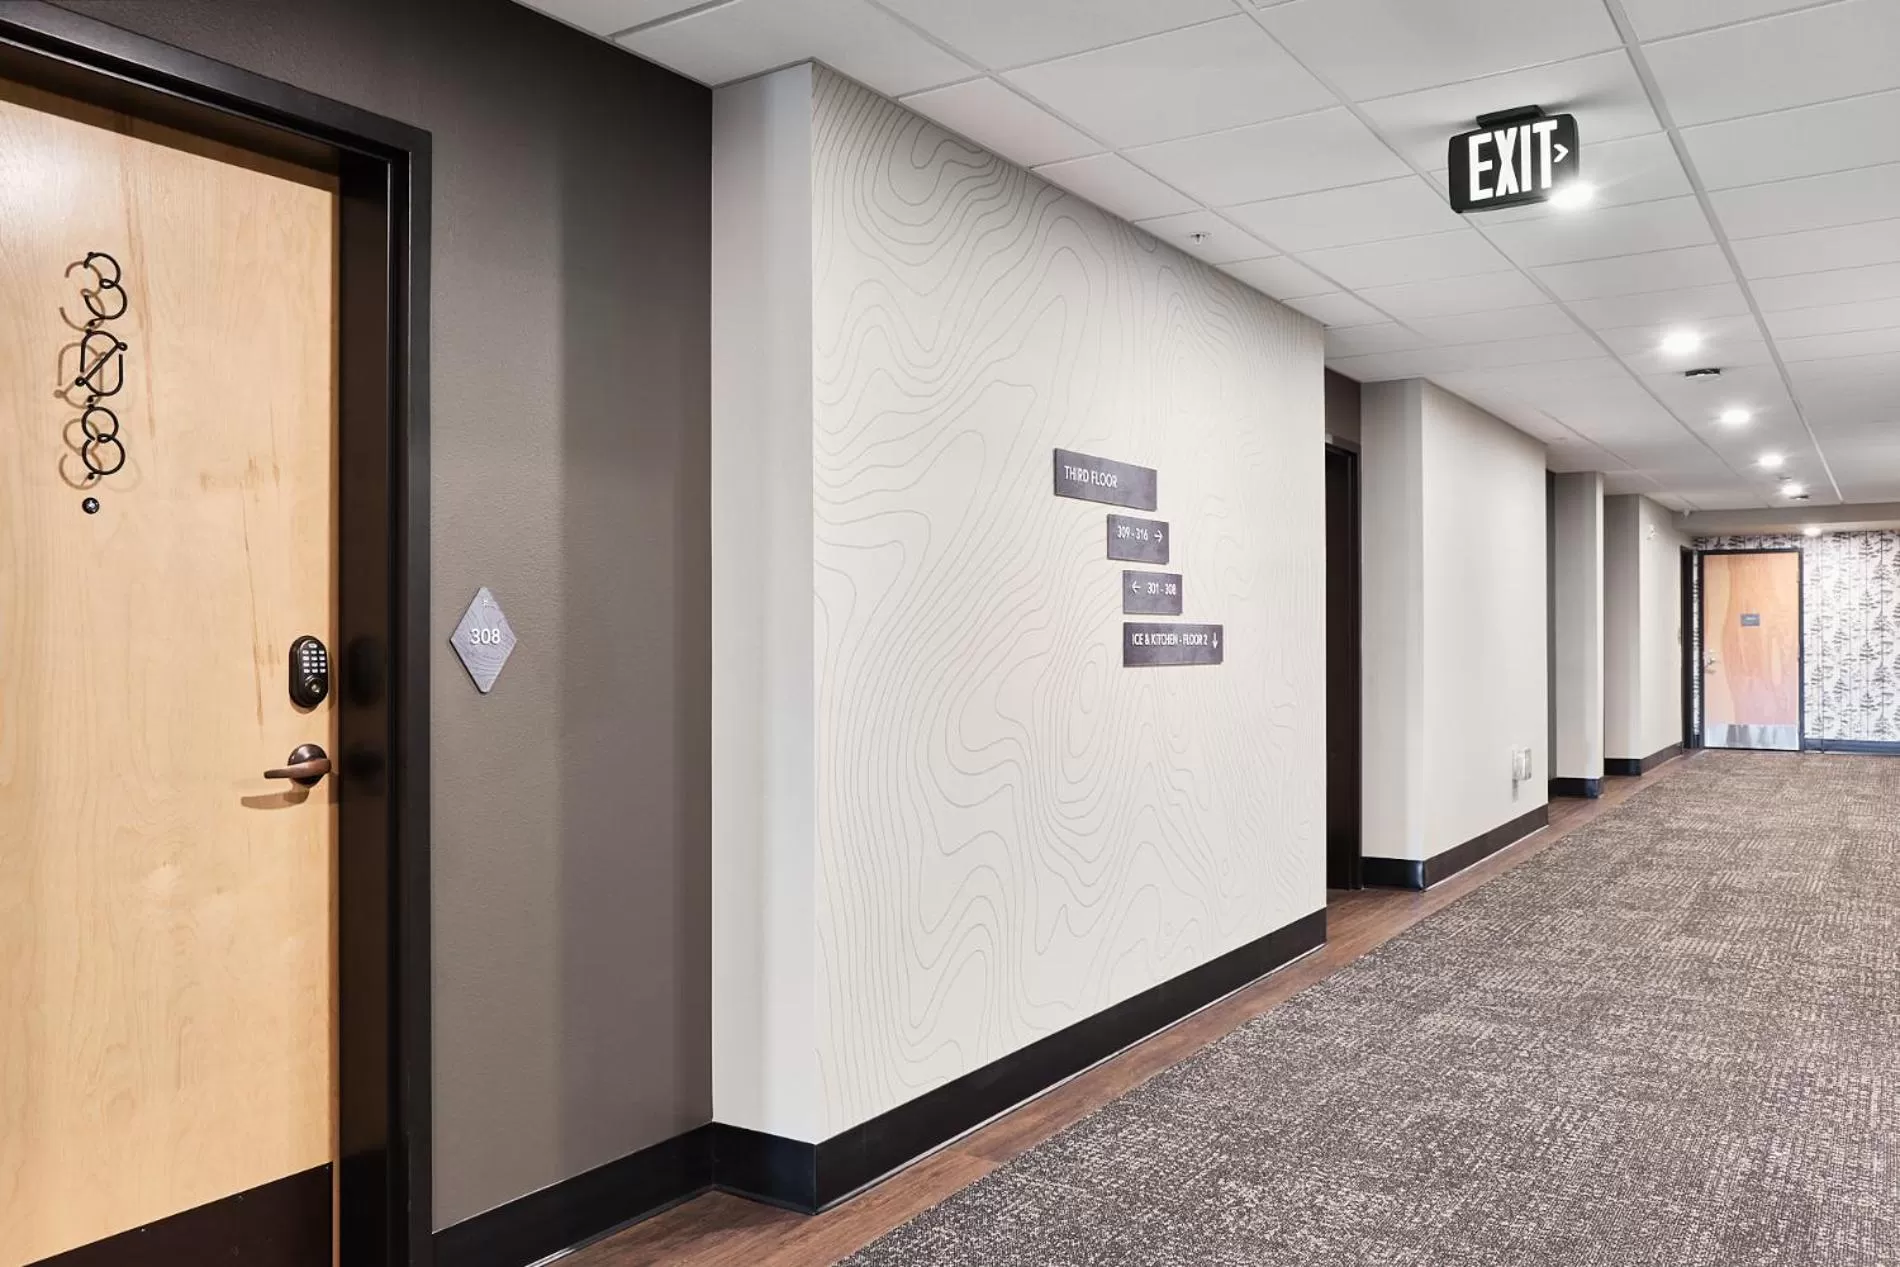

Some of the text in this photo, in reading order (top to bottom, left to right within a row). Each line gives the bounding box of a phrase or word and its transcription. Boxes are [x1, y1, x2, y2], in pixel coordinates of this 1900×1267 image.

[1469, 120, 1558, 202] EXIT
[1064, 465, 1118, 488] THIRD FLOOR
[1117, 525, 1130, 538] 309
[1136, 527, 1148, 540] 316
[1147, 582, 1159, 594] 301
[470, 628, 501, 645] 308
[1132, 632, 1143, 645] ICE
[1145, 633, 1149, 645] &
[1151, 632, 1178, 645] KITCHEN
[1183, 633, 1202, 645] FLOOR
[1203, 633, 1208, 645] 2
